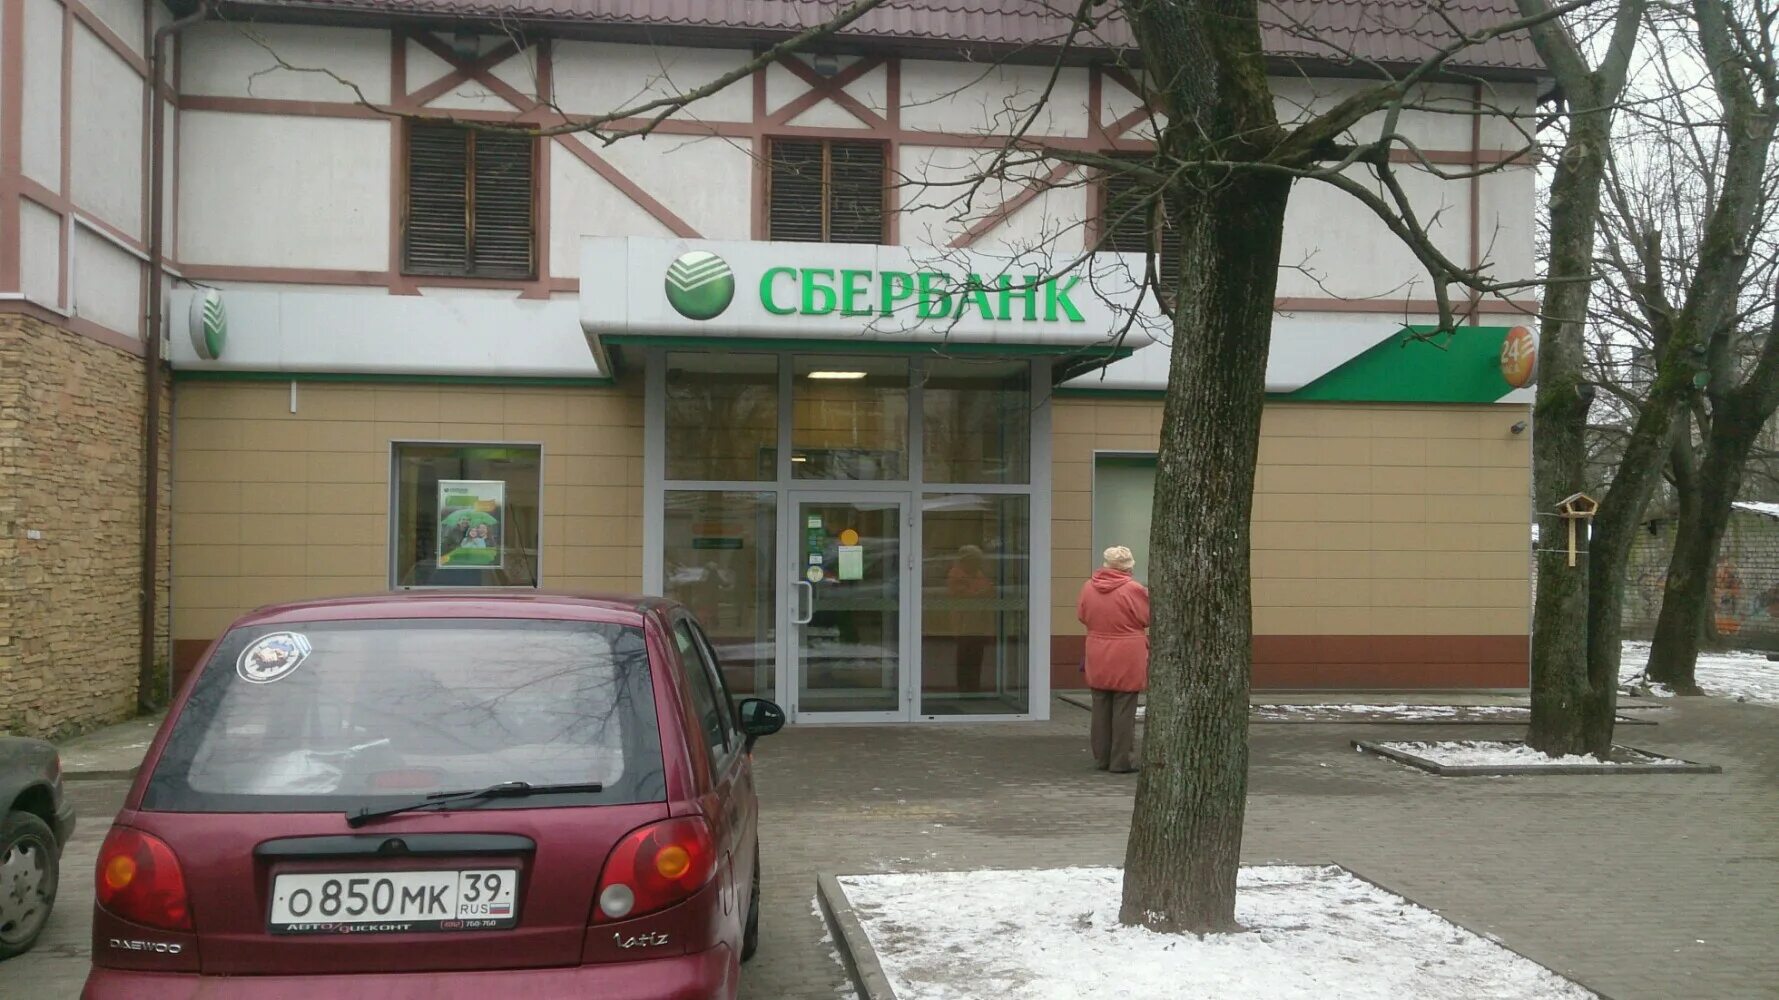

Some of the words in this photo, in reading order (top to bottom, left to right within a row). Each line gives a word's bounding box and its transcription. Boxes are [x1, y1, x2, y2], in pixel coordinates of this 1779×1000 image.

[759, 266, 1085, 322] СБЕРБАНК
[1501, 337, 1520, 363] 24
[463, 873, 501, 903] 39
[460, 903, 488, 914] RUS
[110, 939, 181, 953] DAEWOO
